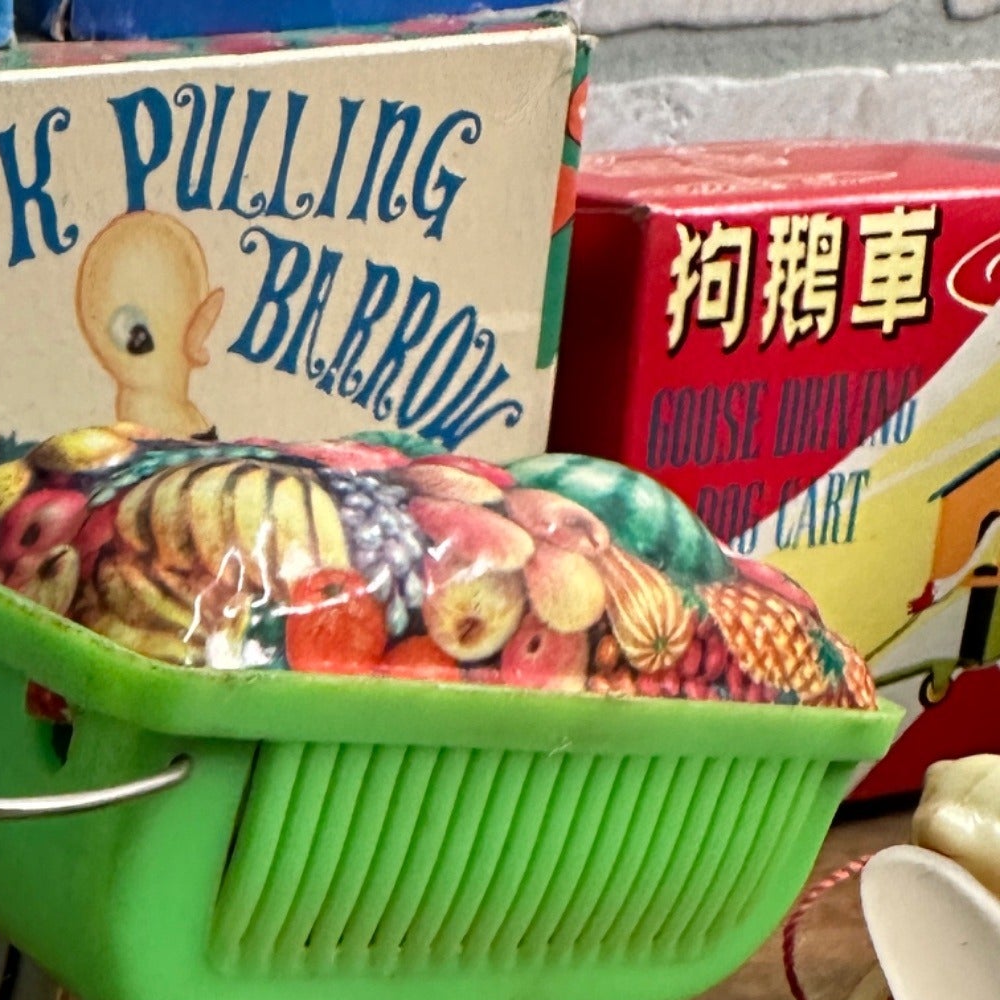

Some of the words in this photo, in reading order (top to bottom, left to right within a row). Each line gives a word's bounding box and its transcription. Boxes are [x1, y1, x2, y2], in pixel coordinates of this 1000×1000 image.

[108, 83, 481, 240] PULLING
[227, 226, 523, 452] BARROW
[666, 203, 940, 354] 狗鵝車
[646, 380, 768, 469] GOOSE
[774, 367, 921, 457] DRIVING
[696, 480, 765, 555] DOG
[776, 469, 870, 550] CART
